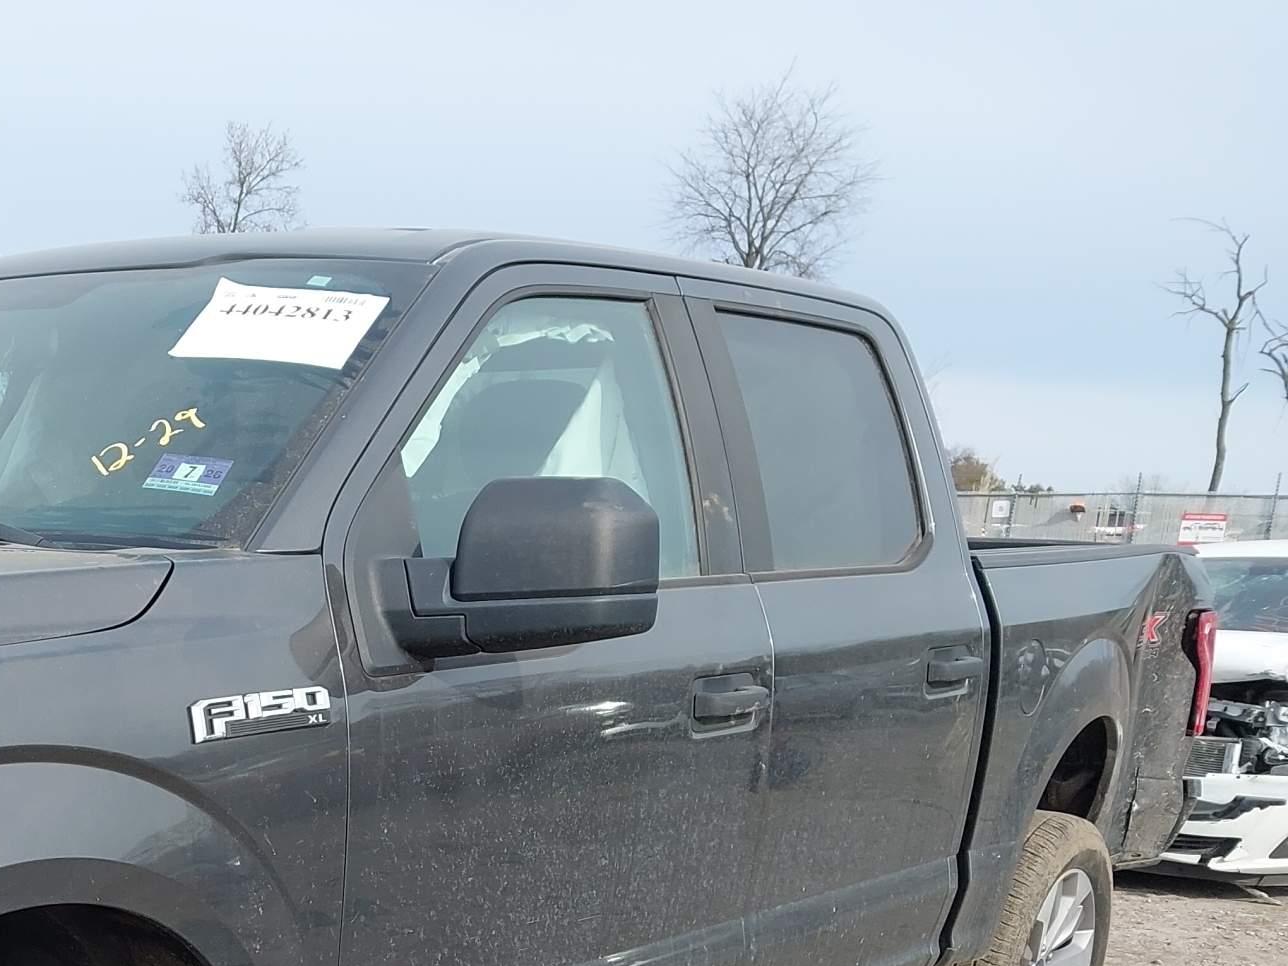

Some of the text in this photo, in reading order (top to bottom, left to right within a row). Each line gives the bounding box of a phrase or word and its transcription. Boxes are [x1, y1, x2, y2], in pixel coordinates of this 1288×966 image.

[219, 302, 354, 323] 44042813
[91, 408, 206, 476] 12-29
[157, 463, 175, 474] 20
[183, 465, 197, 479] 7
[308, 713, 328, 724] XL
